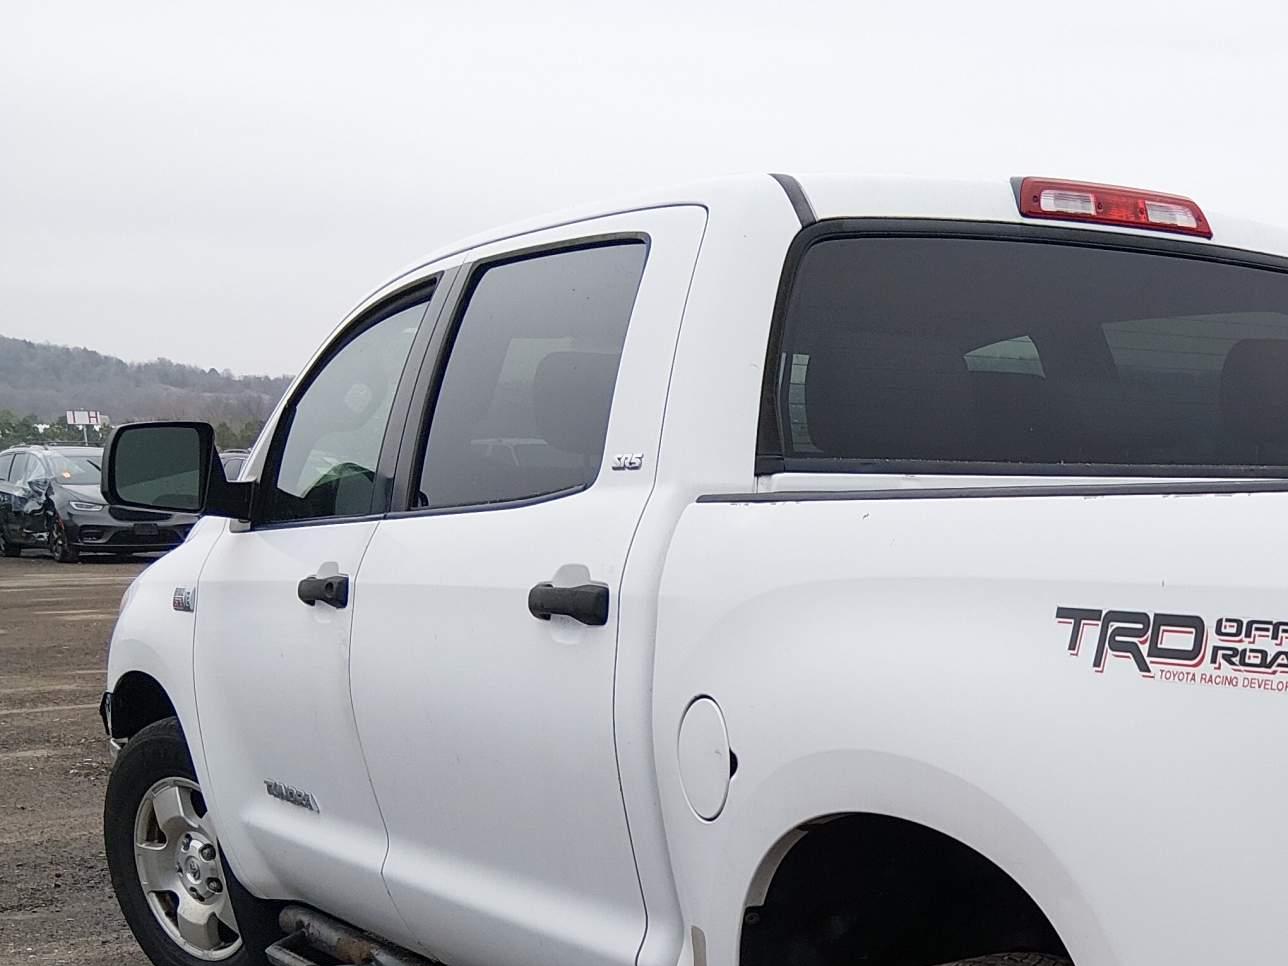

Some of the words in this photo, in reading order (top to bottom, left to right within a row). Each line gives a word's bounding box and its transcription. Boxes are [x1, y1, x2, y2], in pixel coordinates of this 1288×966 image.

[612, 453, 645, 471] SR5
[1055, 605, 1209, 679] TRD
[1159, 669, 1196, 683] TOYOTA
[1200, 674, 1239, 688] RACING
